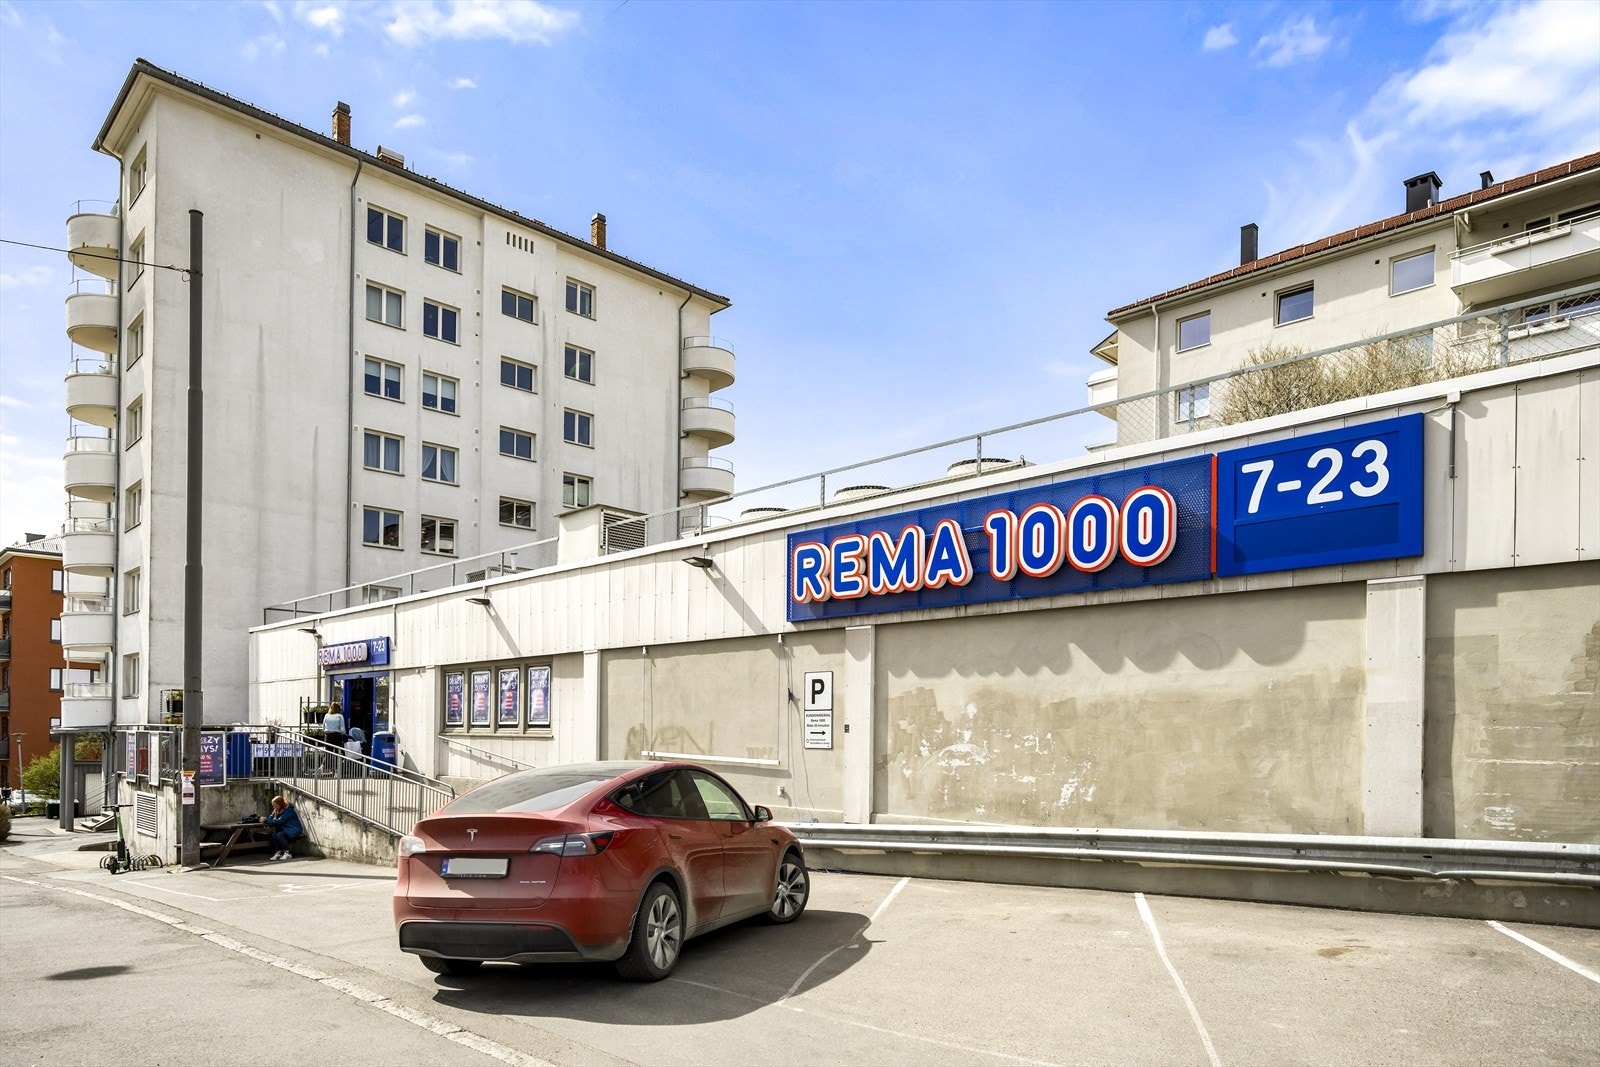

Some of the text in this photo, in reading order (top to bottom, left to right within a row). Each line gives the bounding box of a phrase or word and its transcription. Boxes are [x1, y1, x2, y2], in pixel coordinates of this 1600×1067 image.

[1241, 439, 1390, 514] 7-23
[794, 485, 1176, 603] REMA 1000
[319, 643, 363, 665] REMA 1000
[372, 641, 386, 653] 7-23
[811, 679, 825, 704] P
